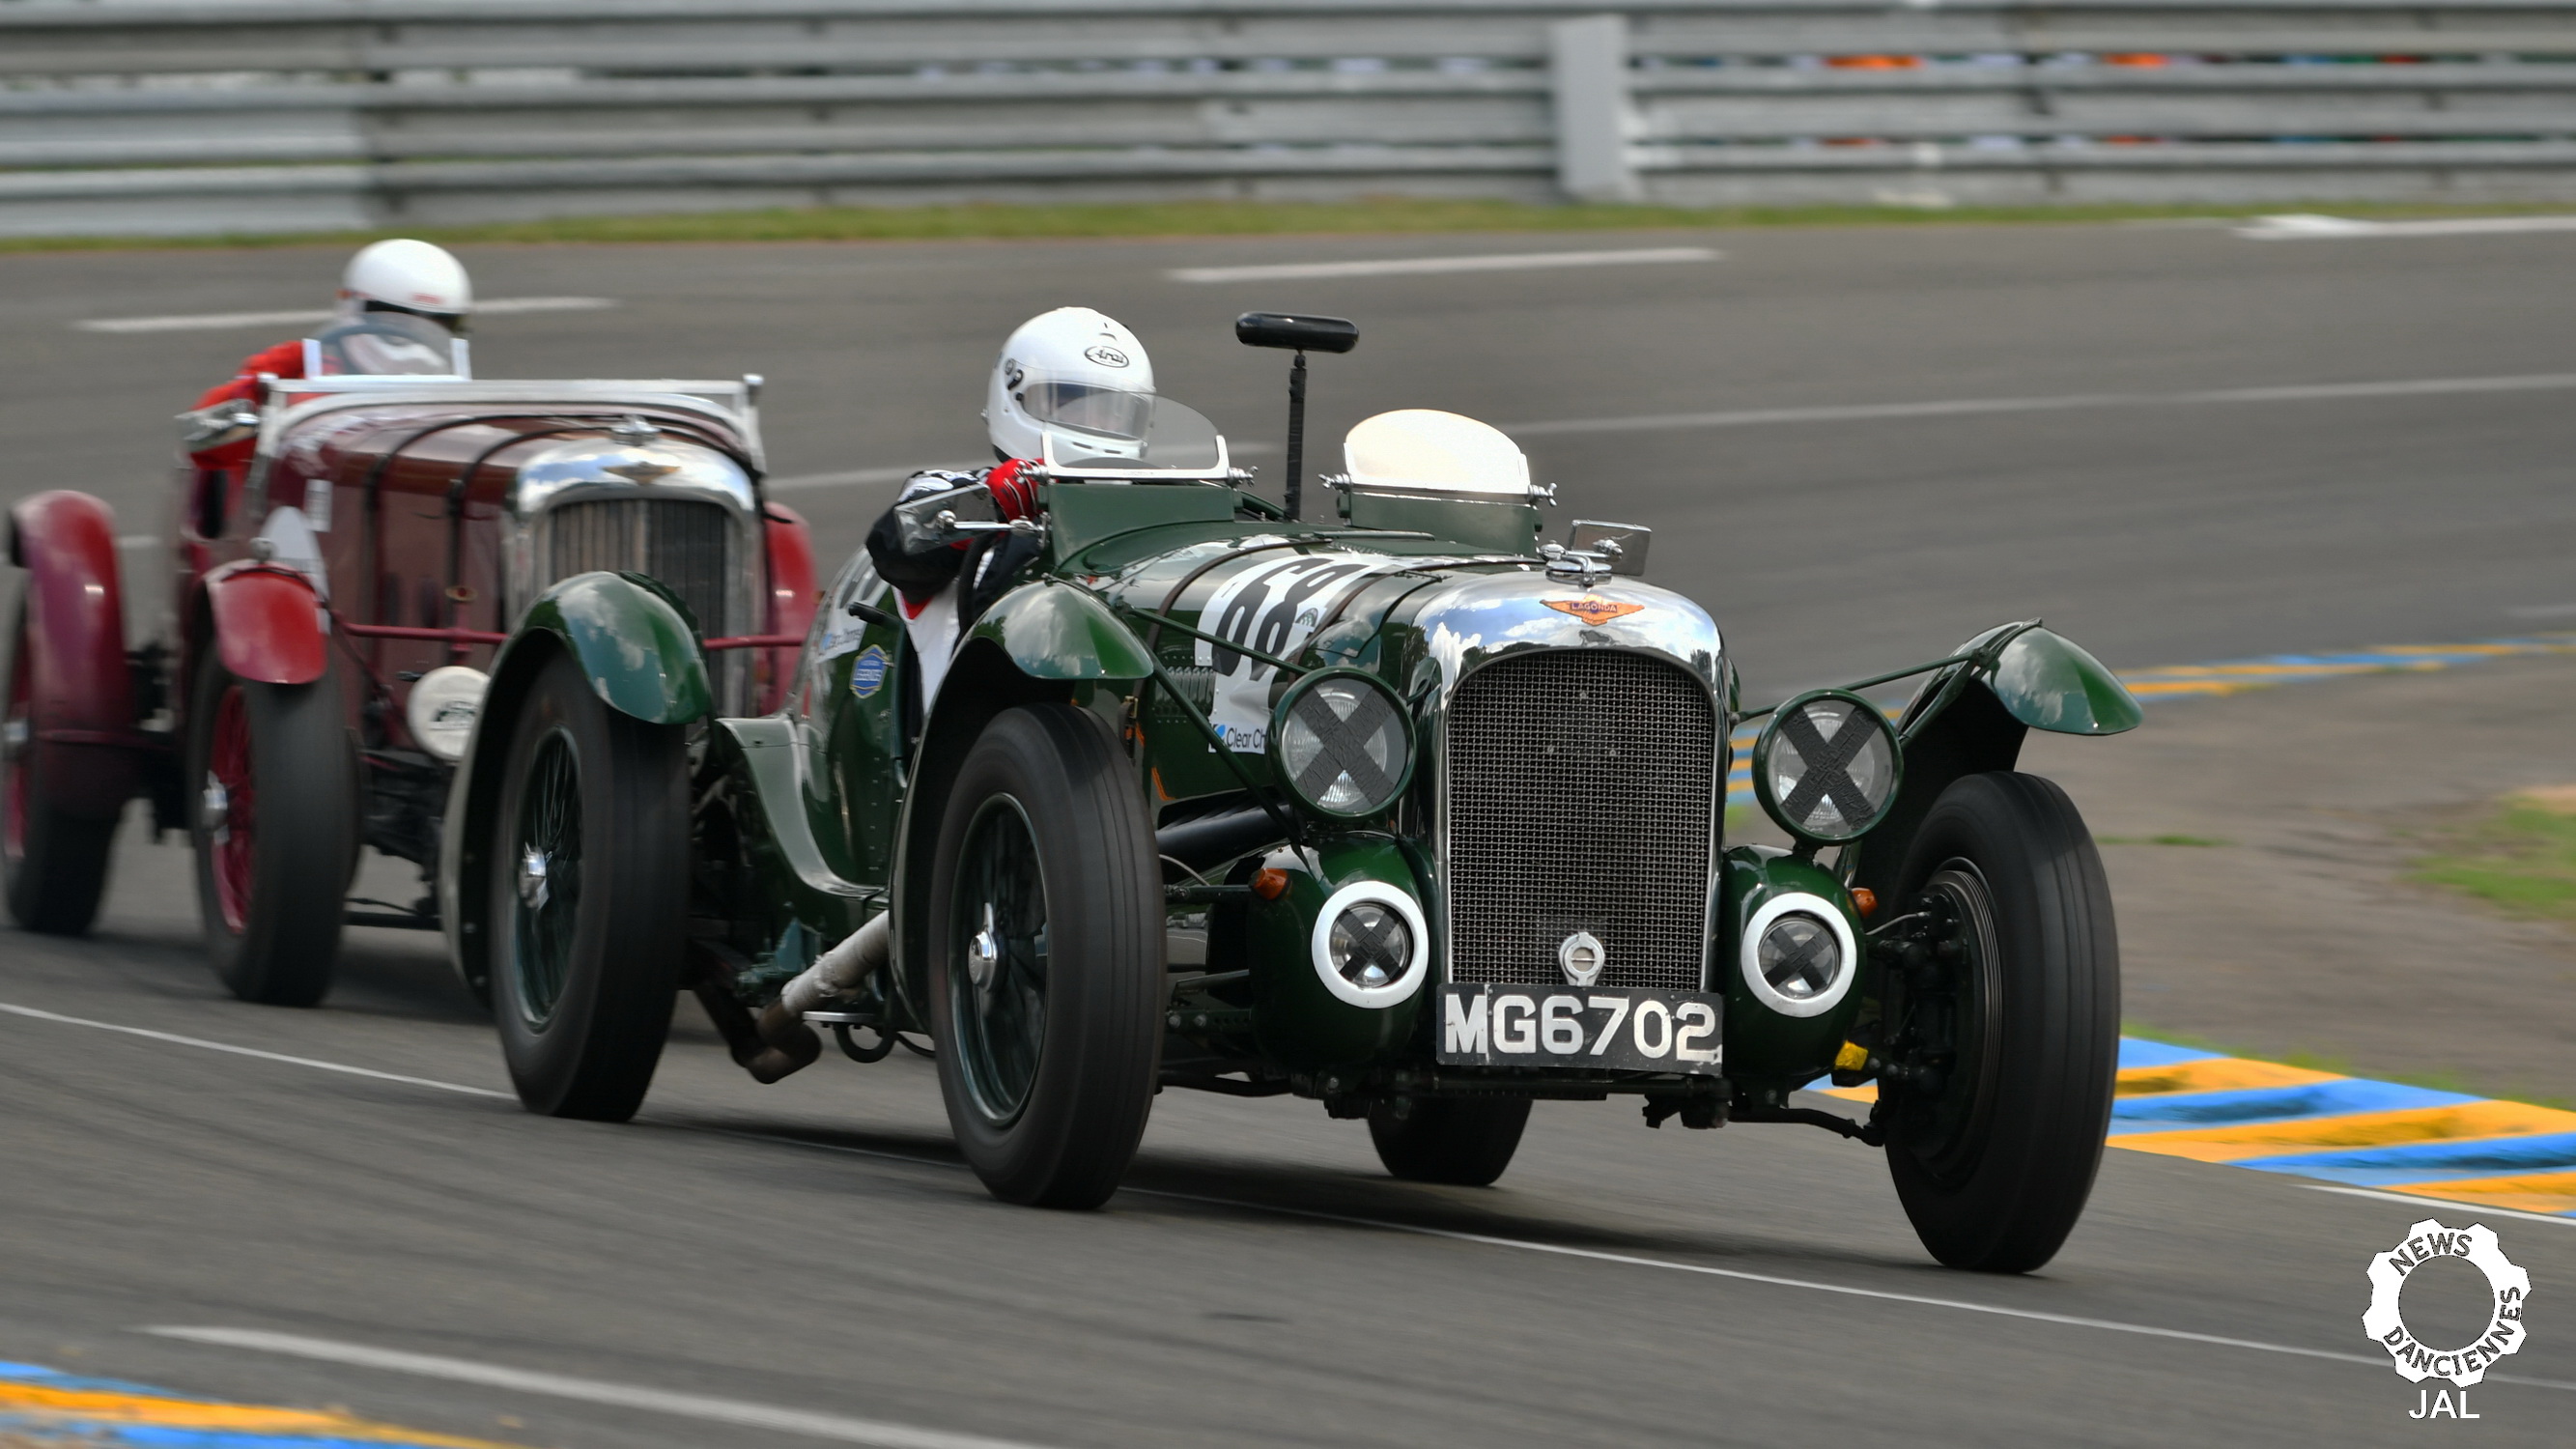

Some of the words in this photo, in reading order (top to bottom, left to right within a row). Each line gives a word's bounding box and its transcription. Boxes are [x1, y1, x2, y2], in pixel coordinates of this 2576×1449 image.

[1211, 558, 1370, 681] 68
[1571, 602, 1617, 612] LAGONDA
[1226, 727, 1252, 748] Clear
[1253, 728, 1266, 749] Ch
[1445, 993, 1722, 1062] MG6702
